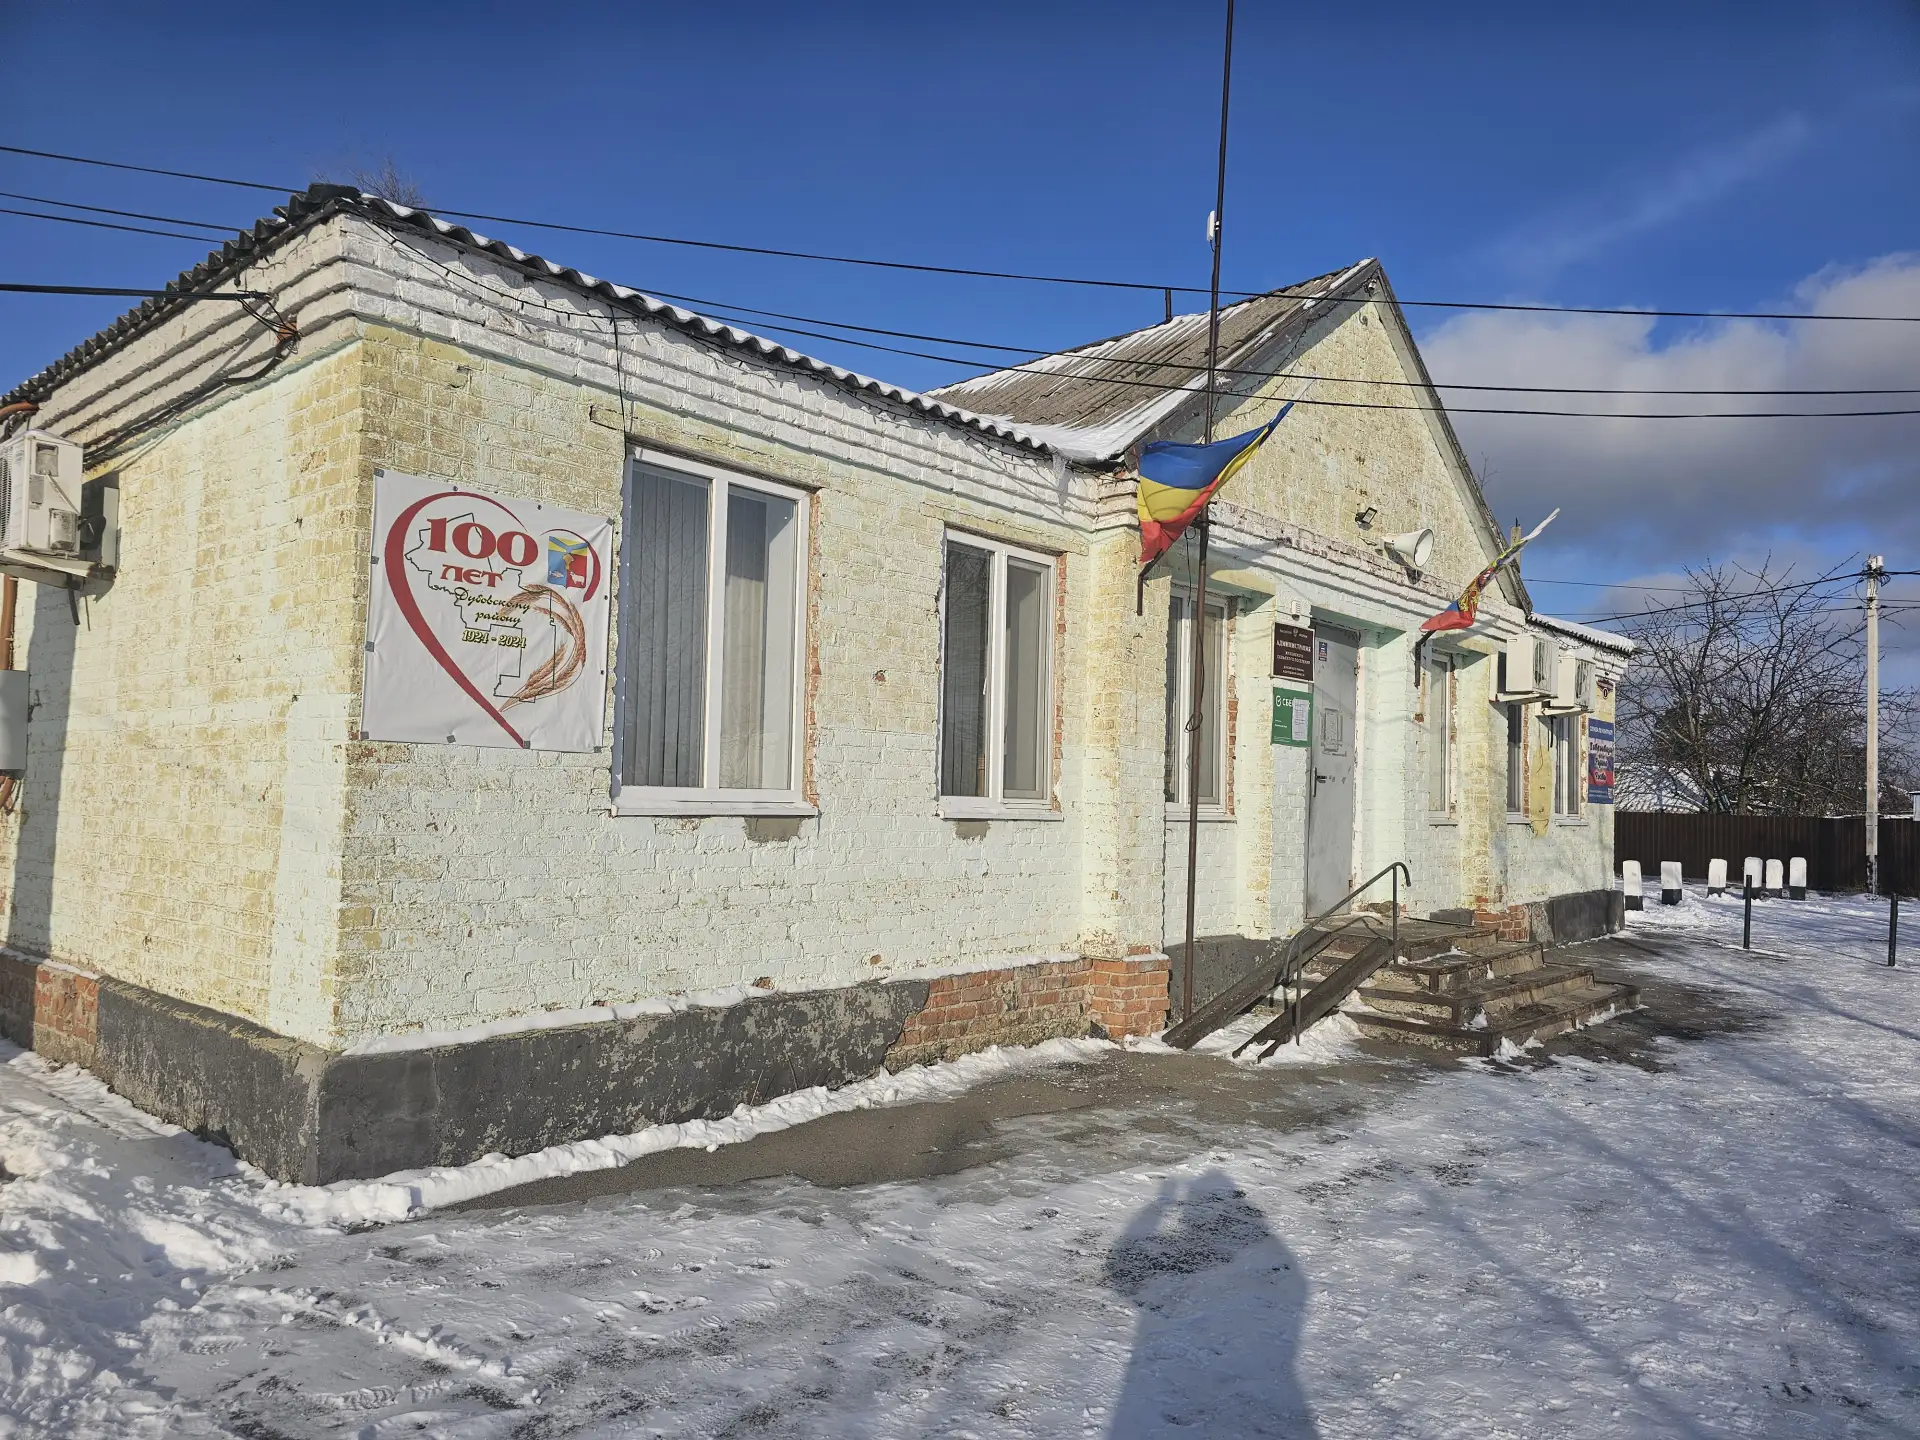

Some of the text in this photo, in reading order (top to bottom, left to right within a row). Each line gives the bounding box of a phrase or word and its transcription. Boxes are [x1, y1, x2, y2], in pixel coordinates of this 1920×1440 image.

[427, 518, 539, 567] 100
[454, 587, 531, 614] Дубовскому
[474, 611, 522, 628] району
[462, 630, 489, 644] 1924
[498, 635, 527, 648] 2024
